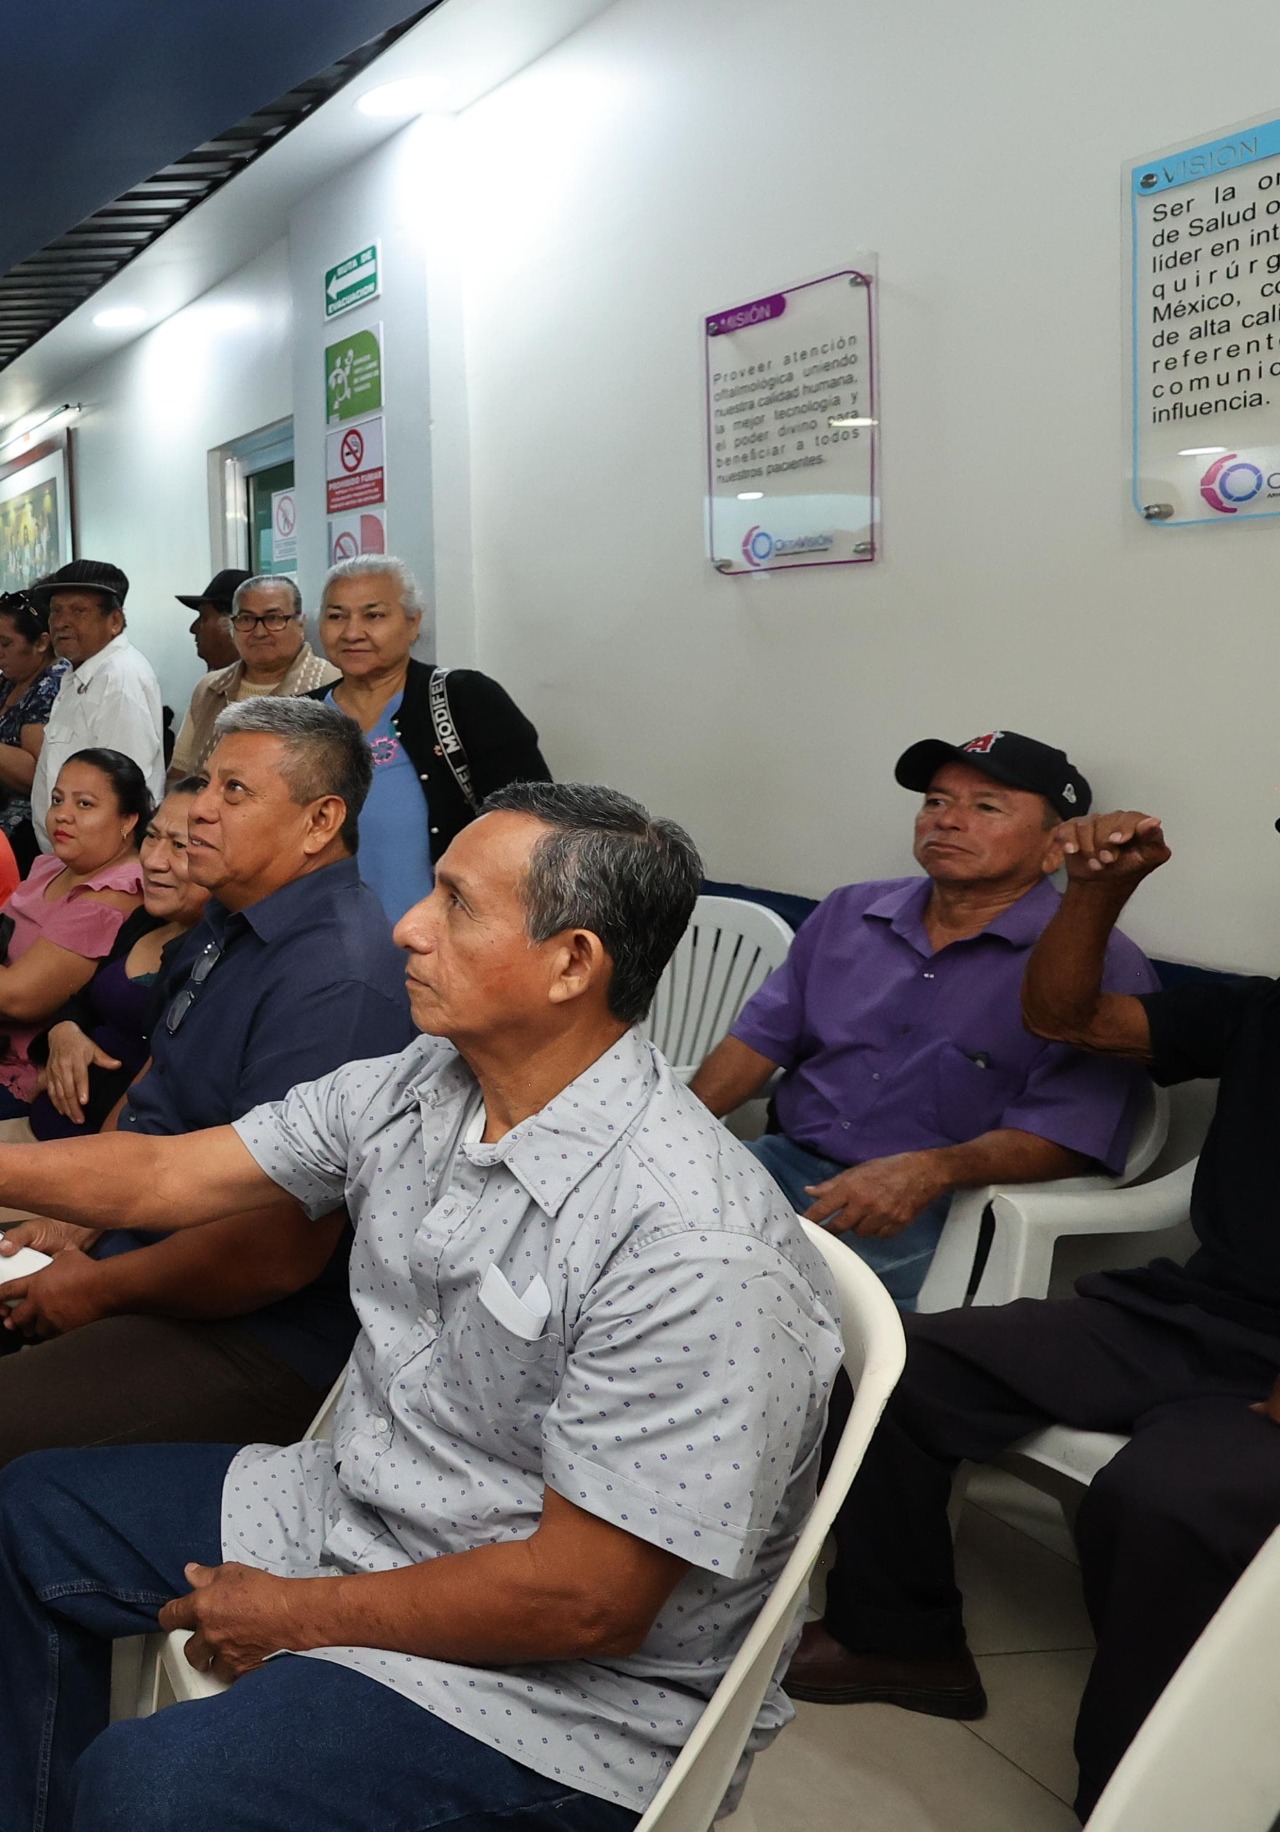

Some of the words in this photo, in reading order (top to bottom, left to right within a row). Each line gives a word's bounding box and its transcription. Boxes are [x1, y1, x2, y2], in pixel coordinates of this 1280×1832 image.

[1152, 197, 1195, 222] Ser
[1215, 185, 1236, 204] la
[1152, 228, 1179, 247] de
[1189, 201, 1256, 237] Salud
[337, 258, 358, 277] RUTA
[360, 248, 374, 265] DE
[1152, 248, 1202, 274] líder
[1211, 238, 1239, 257] en
[1250, 223, 1280, 247] int
[1152, 292, 1241, 323] México,
[1152, 329, 1179, 348] de
[1189, 319, 1231, 340] alta
[713, 360, 773, 385] Proveer
[783, 334, 858, 366] atención
[803, 352, 859, 377] uniendo
[714, 422, 726, 434] la
[732, 413, 767, 431] mejor
[850, 390, 859, 405] y
[1152, 390, 1270, 424] influencia.
[715, 439, 727, 452] el
[733, 430, 770, 449] poder
[796, 440, 805, 451] a
[815, 427, 861, 447] todos
